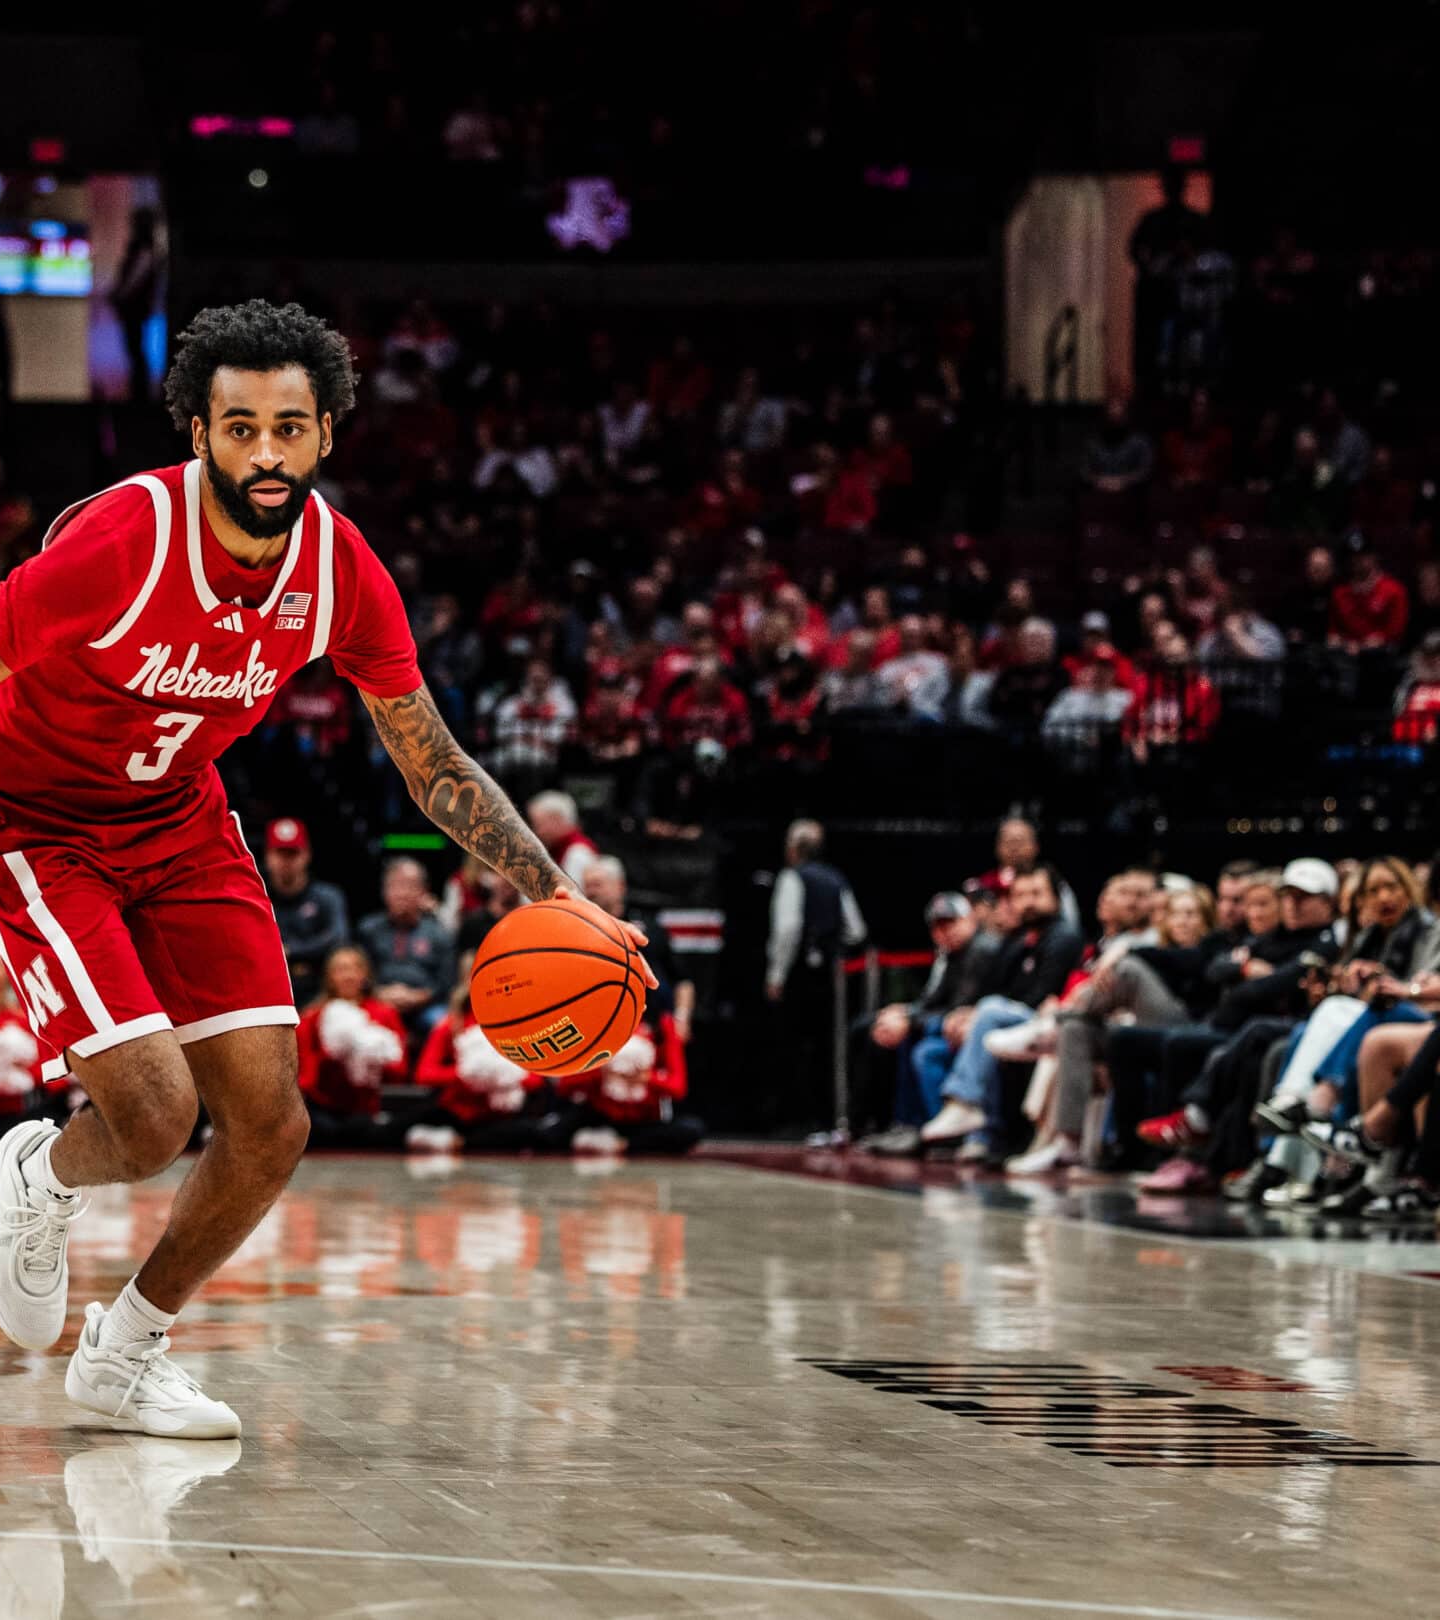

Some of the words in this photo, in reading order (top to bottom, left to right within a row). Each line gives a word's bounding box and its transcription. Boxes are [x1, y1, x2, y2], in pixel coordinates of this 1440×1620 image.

[125, 639, 278, 708] Nebraska
[125, 711, 205, 782] 3
[21, 953, 67, 1029] N
[500, 1023, 584, 1064] ELITE
[793, 1358, 1196, 1398] CITY
[914, 1400, 1440, 1468] VALUE
